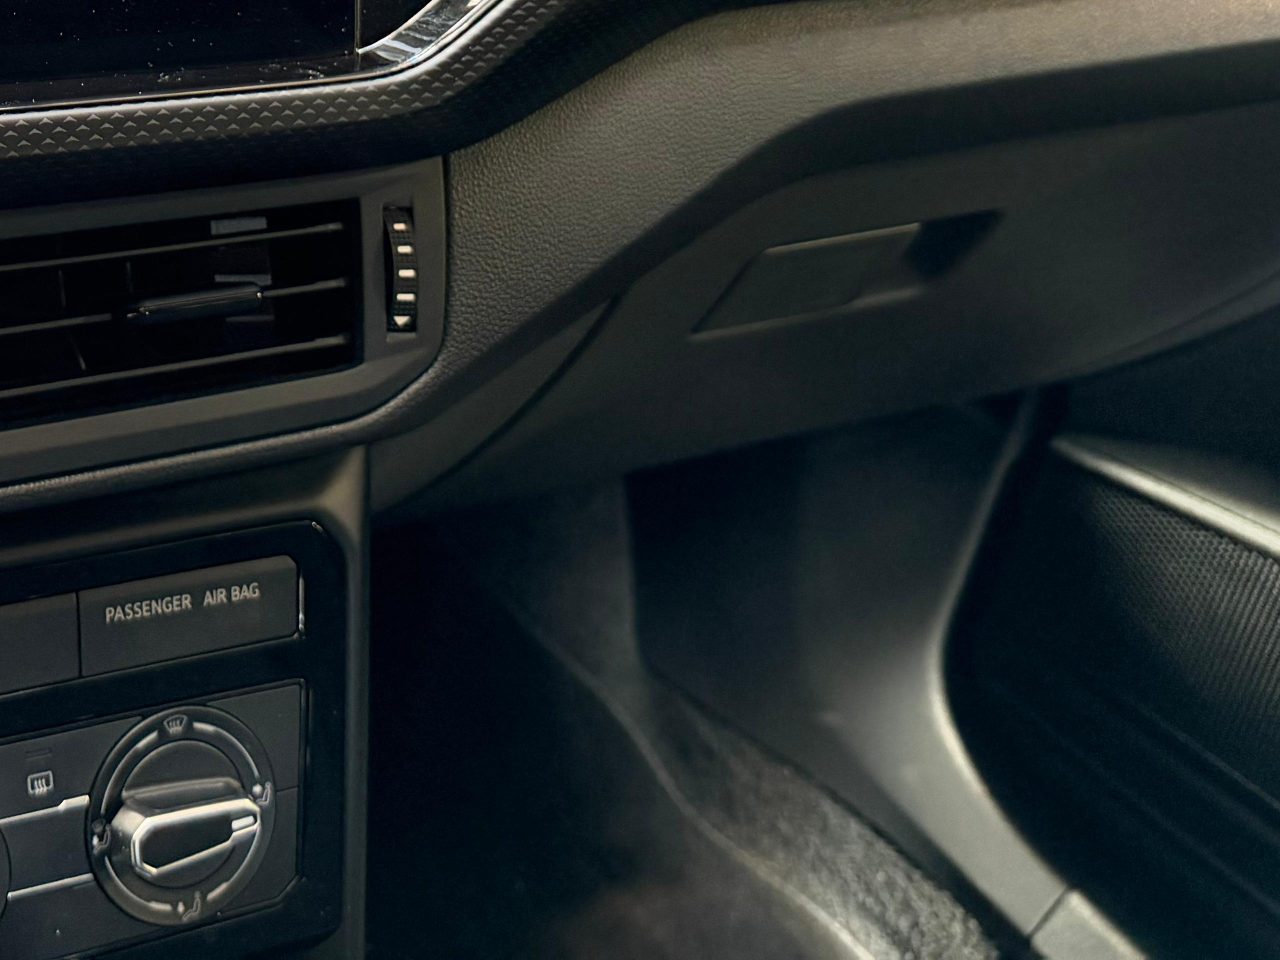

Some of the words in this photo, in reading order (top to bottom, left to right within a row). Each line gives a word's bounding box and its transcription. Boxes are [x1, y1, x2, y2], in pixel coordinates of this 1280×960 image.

[105, 593, 192, 624] PASSENGER
[203, 588, 227, 607] AIR
[231, 582, 260, 601] BAG
